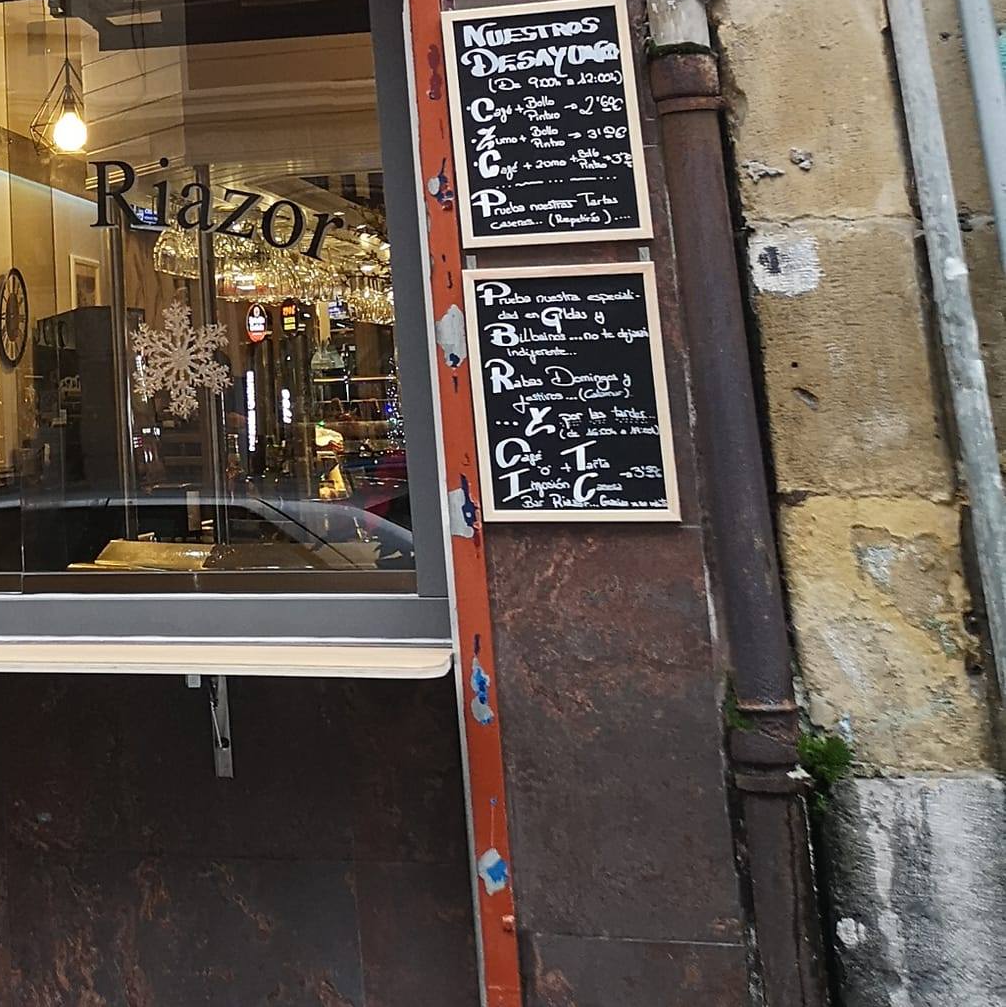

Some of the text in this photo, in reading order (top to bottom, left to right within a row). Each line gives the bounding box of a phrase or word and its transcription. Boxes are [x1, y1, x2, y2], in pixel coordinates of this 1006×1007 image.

[463, 17, 600, 48] NUESTROS
[523, 96, 556, 109] Bollo
[529, 125, 559, 137] Bollo
[89, 157, 346, 262] Riazor
[471, 189, 525, 218] Prueba
[576, 192, 619, 207] Tartas
[476, 281, 532, 306] Prueba
[535, 291, 582, 303] nuestra
[497, 310, 520, 321] dad
[594, 311, 606, 325] y
[484, 358, 544, 394] Rabas
[622, 373, 632, 388] y
[560, 440, 611, 471] Tarta
